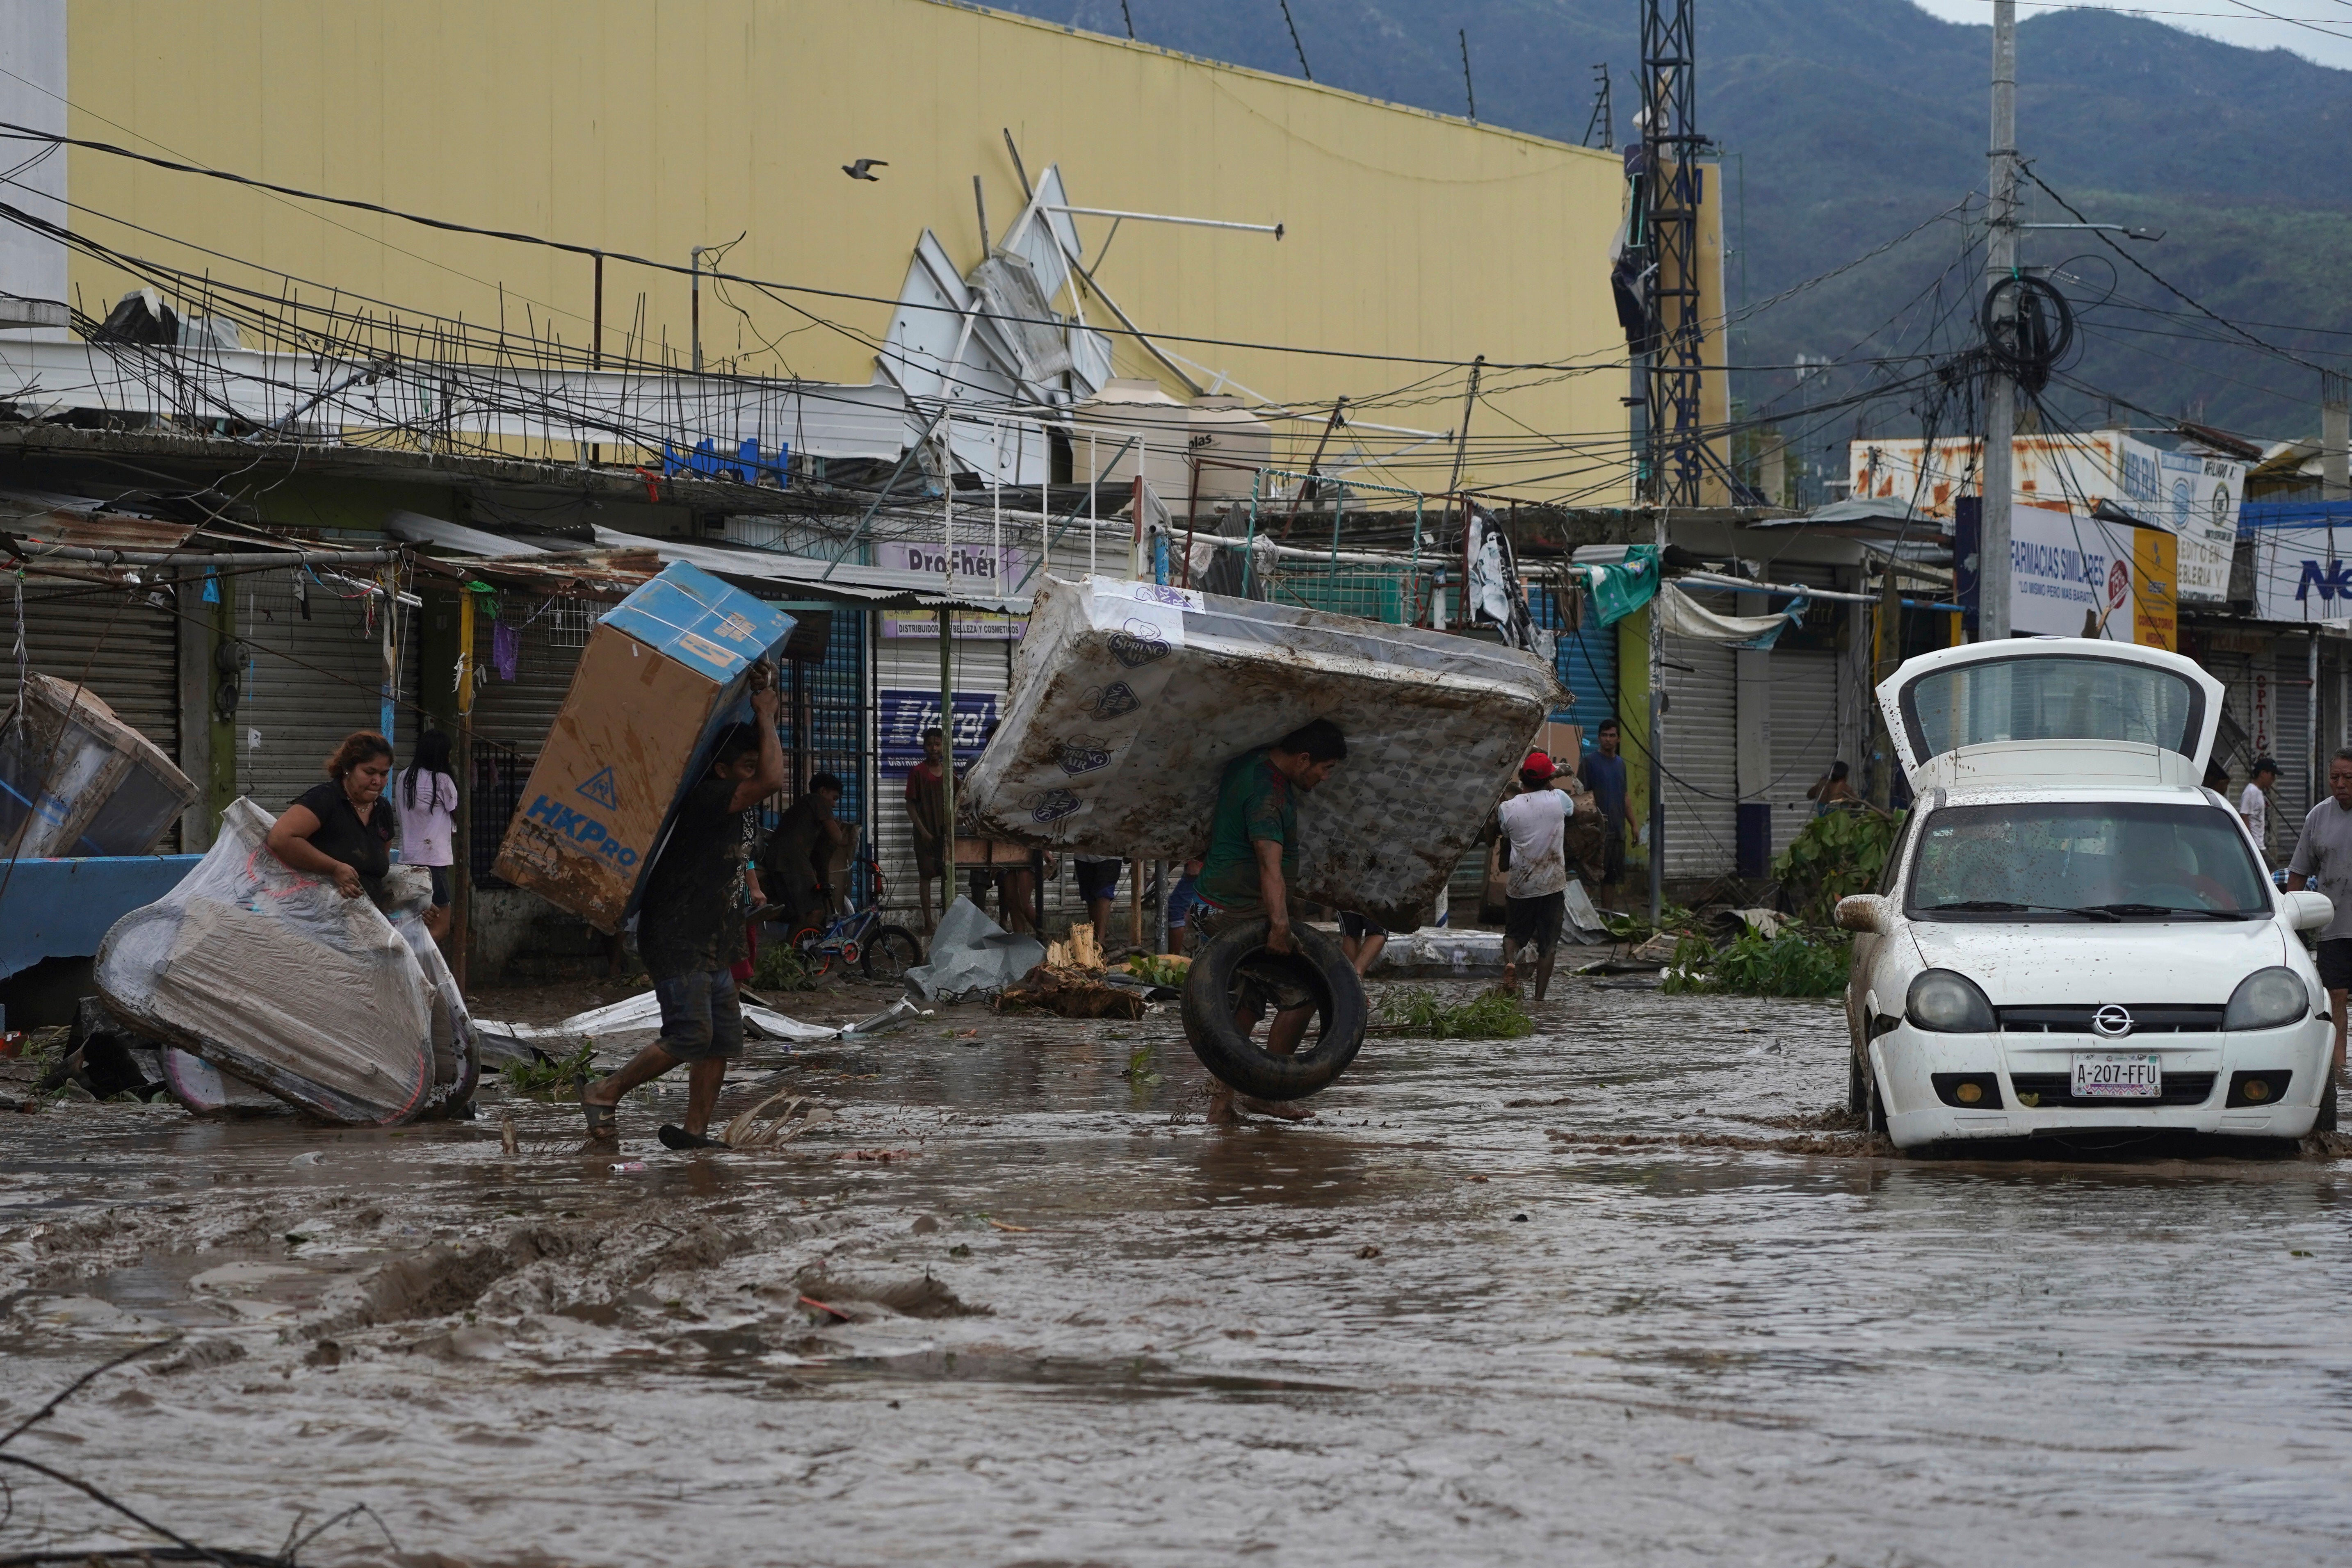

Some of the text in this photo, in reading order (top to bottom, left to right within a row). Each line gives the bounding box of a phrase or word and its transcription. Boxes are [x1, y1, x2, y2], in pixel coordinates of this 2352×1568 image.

[2010, 540, 2058, 579] FARMACIAS
[2061, 548, 2104, 587] SIMILARES
[899, 624, 940, 633] DISTRIBUIDOR
[953, 624, 977, 634] BELLEZA
[978, 625, 982, 634] Y
[984, 625, 1019, 634] COSMETICOS
[1113, 637, 1164, 657] SPRING
[1123, 651, 1148, 663] AIR
[916, 701, 989, 746] tecel
[2256, 675, 2267, 760] OPTIC
[1059, 749, 1104, 764] PRING
[1063, 756, 1088, 770] AIR
[2078, 1064, 2156, 1084] A-207-FFU
